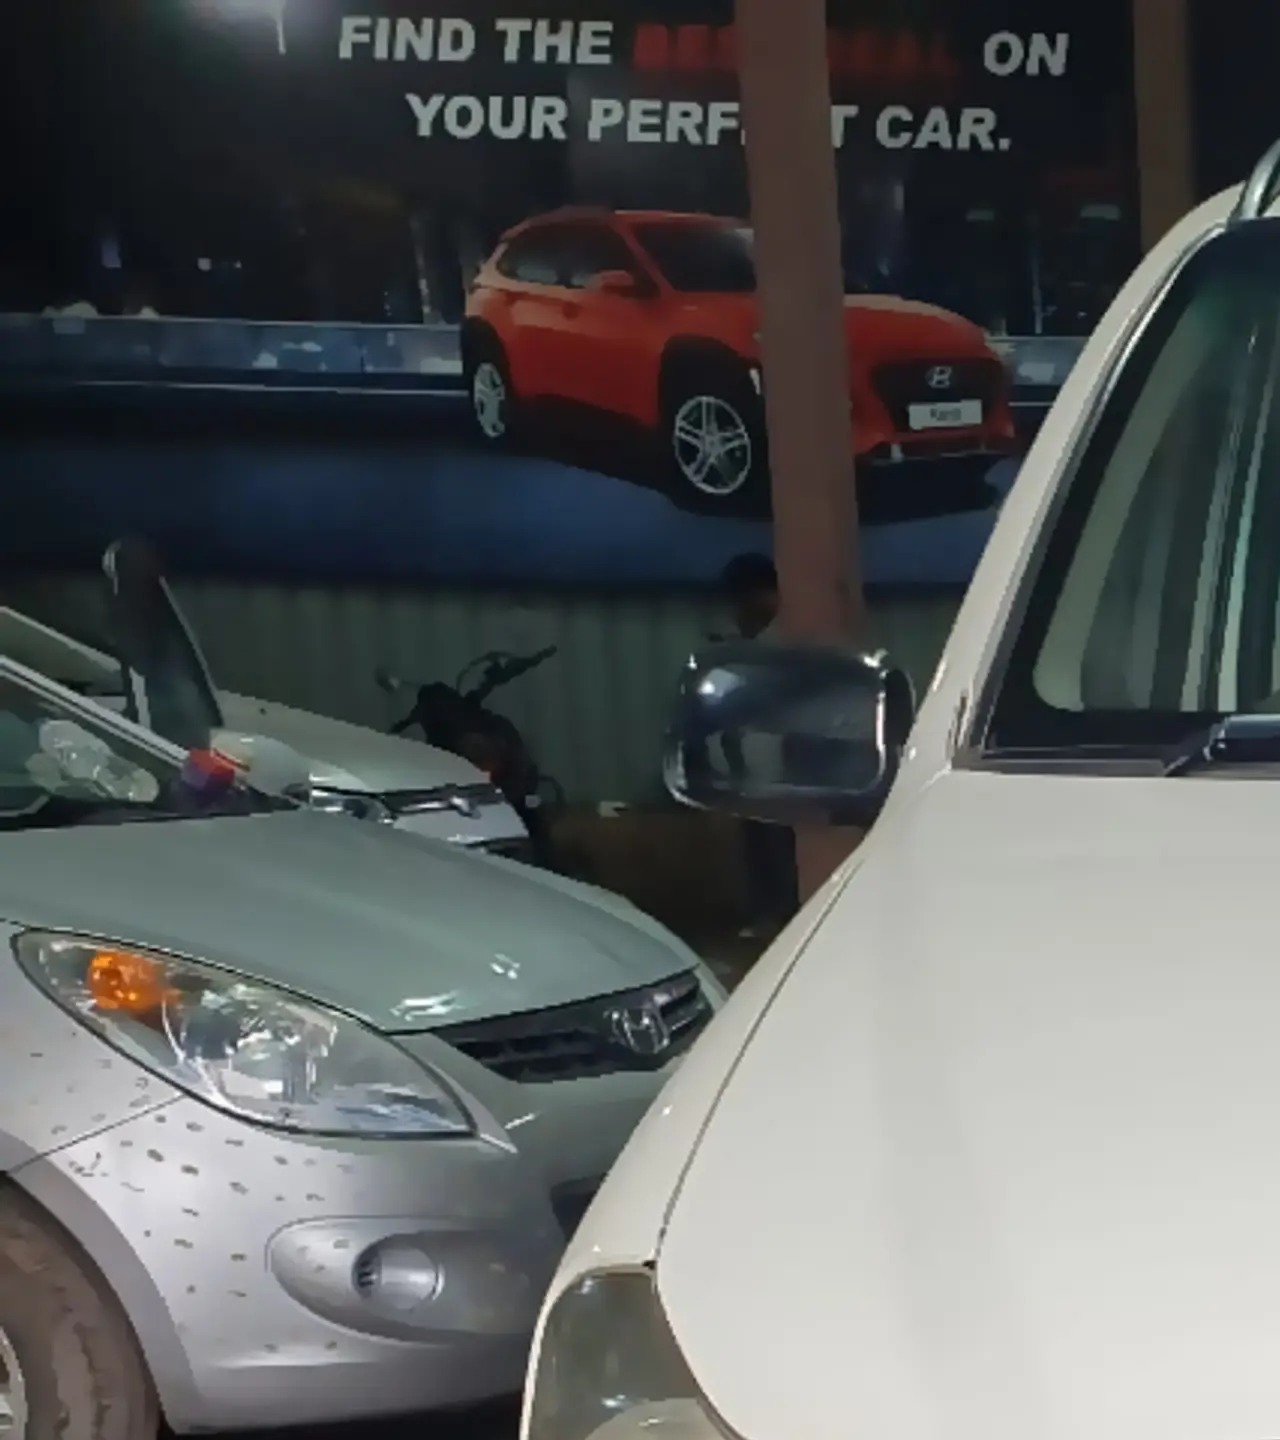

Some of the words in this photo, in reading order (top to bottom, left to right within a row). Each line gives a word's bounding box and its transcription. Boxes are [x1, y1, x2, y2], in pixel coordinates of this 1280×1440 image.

[338, 15, 477, 62] FIND
[495, 18, 613, 65] THE
[983, 31, 1069, 77] ON
[405, 93, 569, 140] YOUR
[587, 98, 859, 150] PERFT
[875, 104, 1011, 152] CAR.
